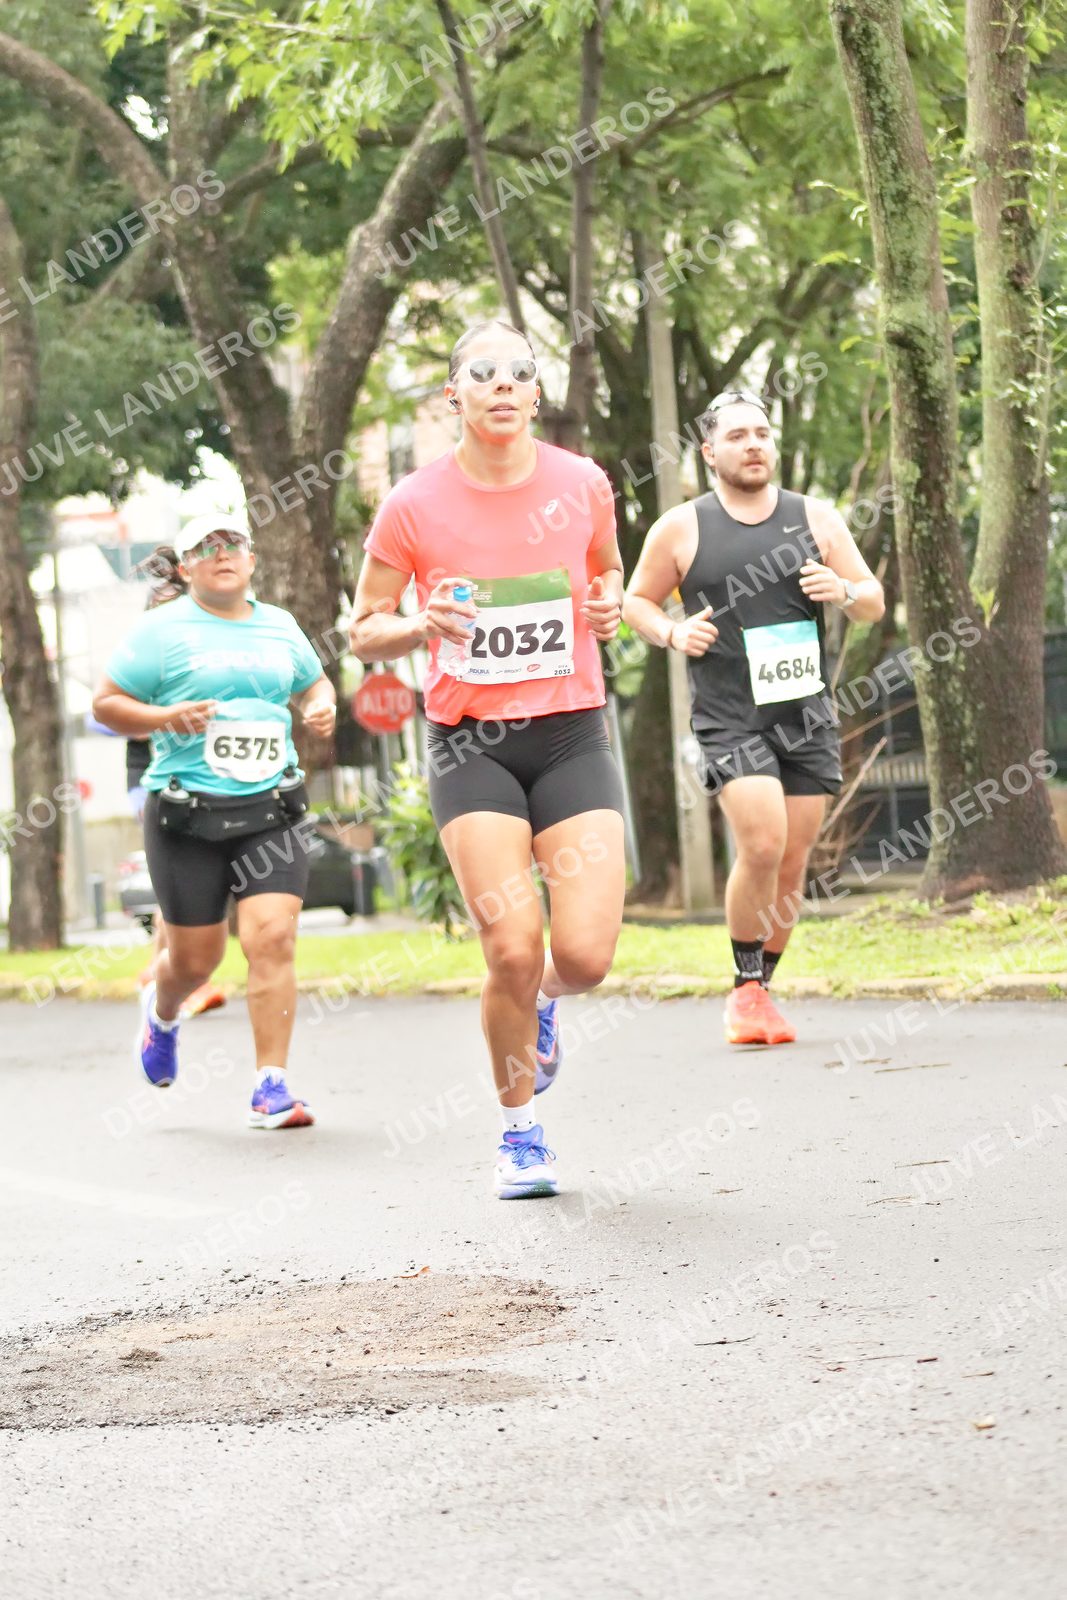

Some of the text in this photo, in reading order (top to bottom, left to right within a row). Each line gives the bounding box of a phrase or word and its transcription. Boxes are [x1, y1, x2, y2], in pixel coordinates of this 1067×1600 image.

[471, 620, 566, 659] 2032
[758, 656, 816, 683] 4684
[361, 688, 412, 716] ALTO
[214, 736, 279, 761] 6375
